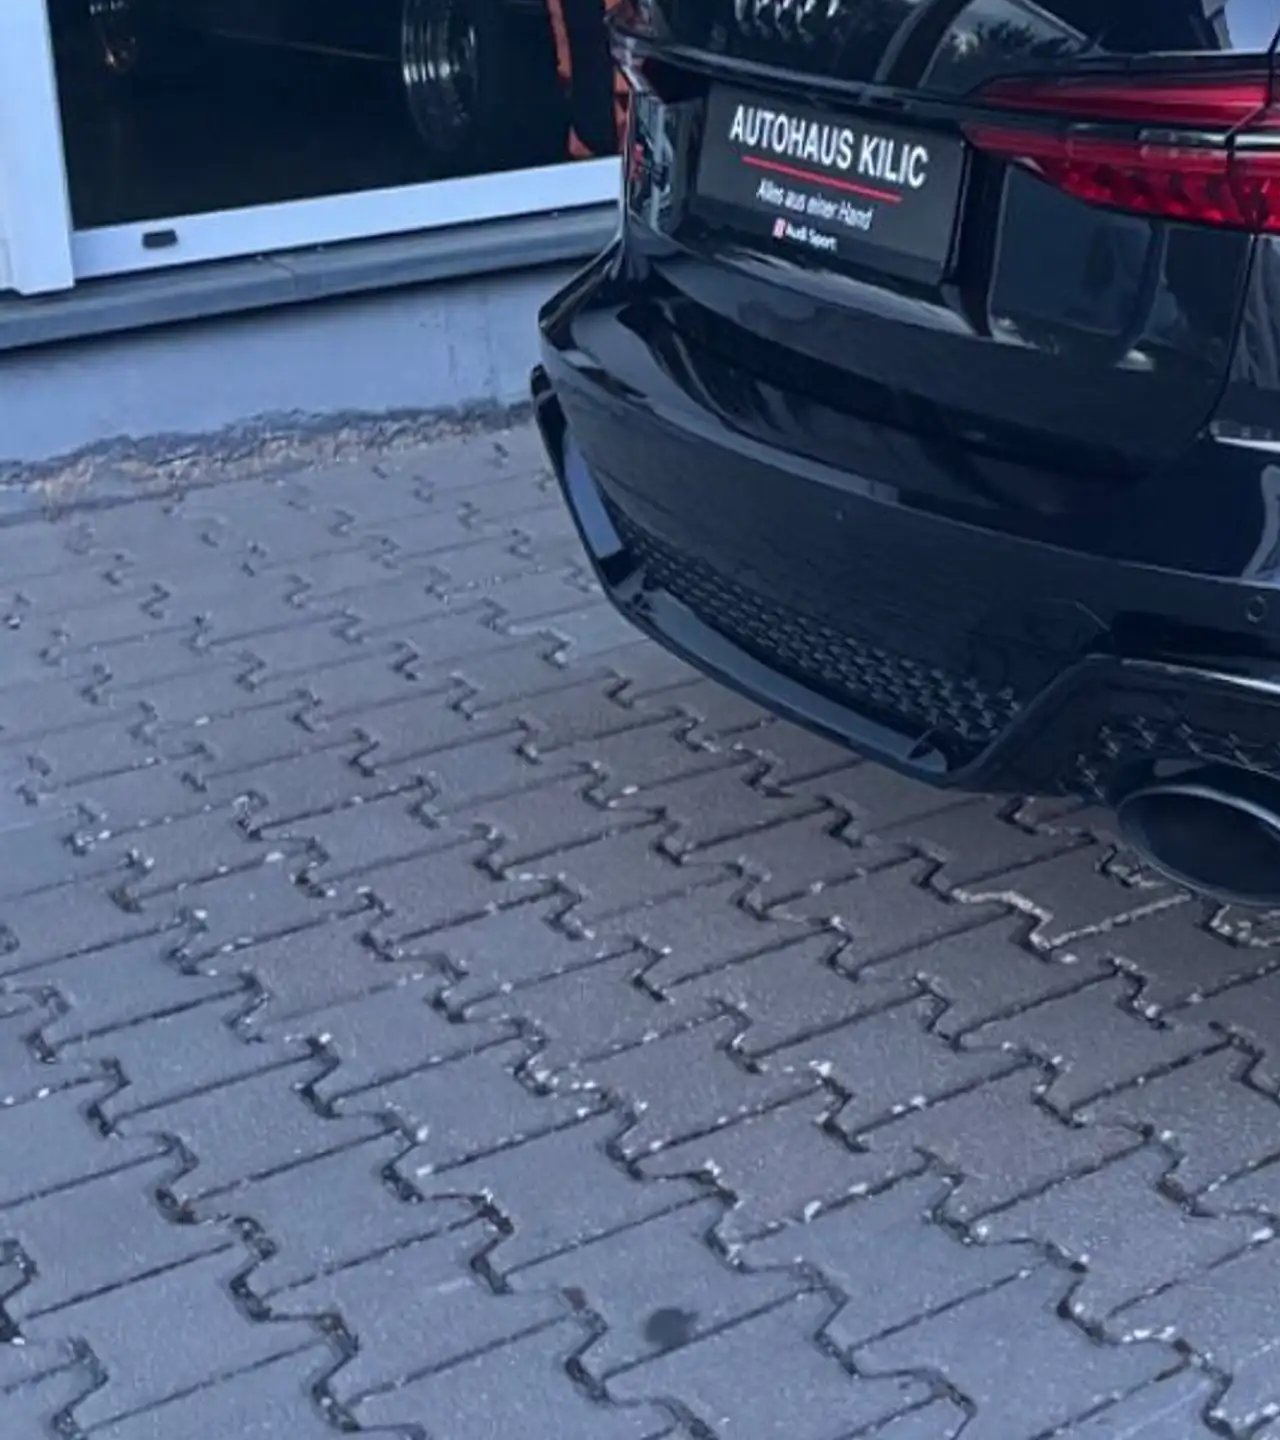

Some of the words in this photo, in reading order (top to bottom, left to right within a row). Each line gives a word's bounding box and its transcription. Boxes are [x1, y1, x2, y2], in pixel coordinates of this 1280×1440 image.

[729, 105, 854, 169] AUTOHAUS
[857, 134, 929, 188] KILIC
[756, 177, 785, 205] Alles
[785, 190, 806, 212] aus
[806, 192, 838, 220] einer
[838, 202, 873, 231] Hand
[785, 222, 808, 242] Audi
[808, 227, 838, 251] Sport
